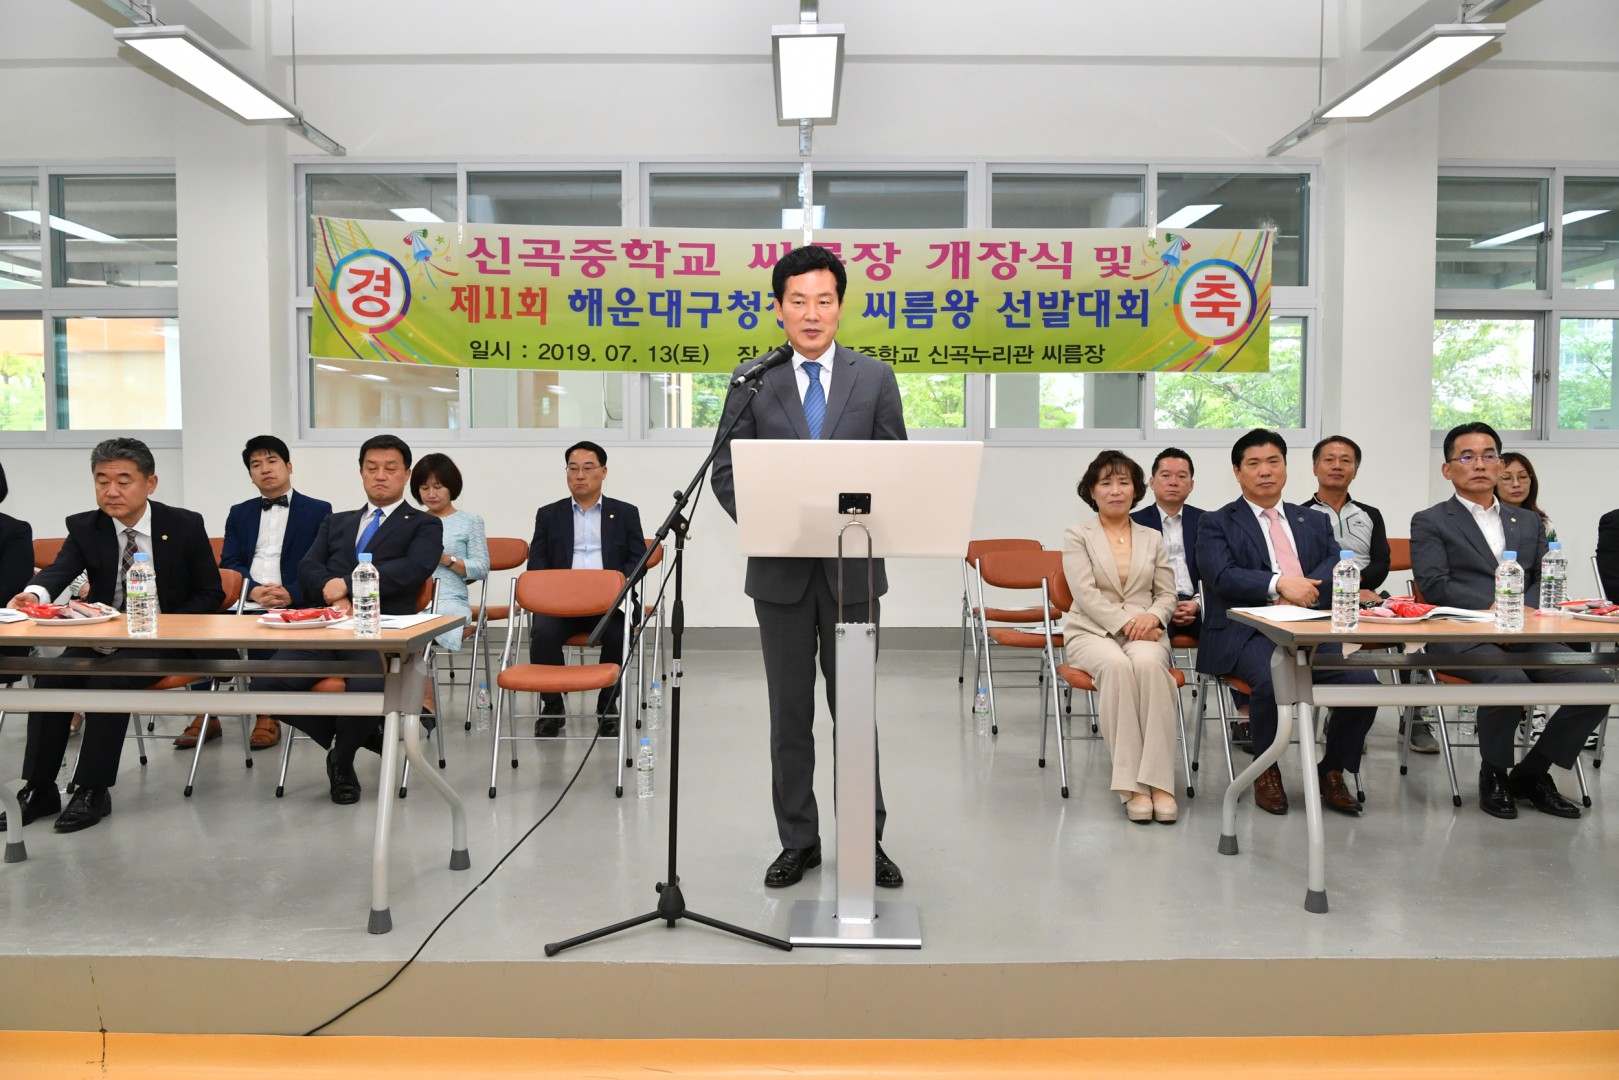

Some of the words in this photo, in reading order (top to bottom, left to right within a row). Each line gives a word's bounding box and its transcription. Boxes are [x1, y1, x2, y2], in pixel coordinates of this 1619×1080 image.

[466, 236, 721, 279] 신곡중학교
[926, 241, 1073, 282] 개장식
[1094, 245, 1132, 278] 및
[347, 266, 391, 318] 경
[450, 285, 548, 325] 제11회
[568, 287, 784, 330] 해운대구청
[861, 289, 979, 330] 씨름왕
[996, 288, 1149, 330] 선발대회
[1190, 274, 1242, 327] 축
[469, 340, 511, 361] 일시
[538, 343, 596, 363] 2019.
[605, 344, 638, 363] 07.
[648, 343, 710, 365] 13(토)
[927, 344, 1035, 365] 신곡누리관
[1041, 344, 1106, 365] 씨름장
